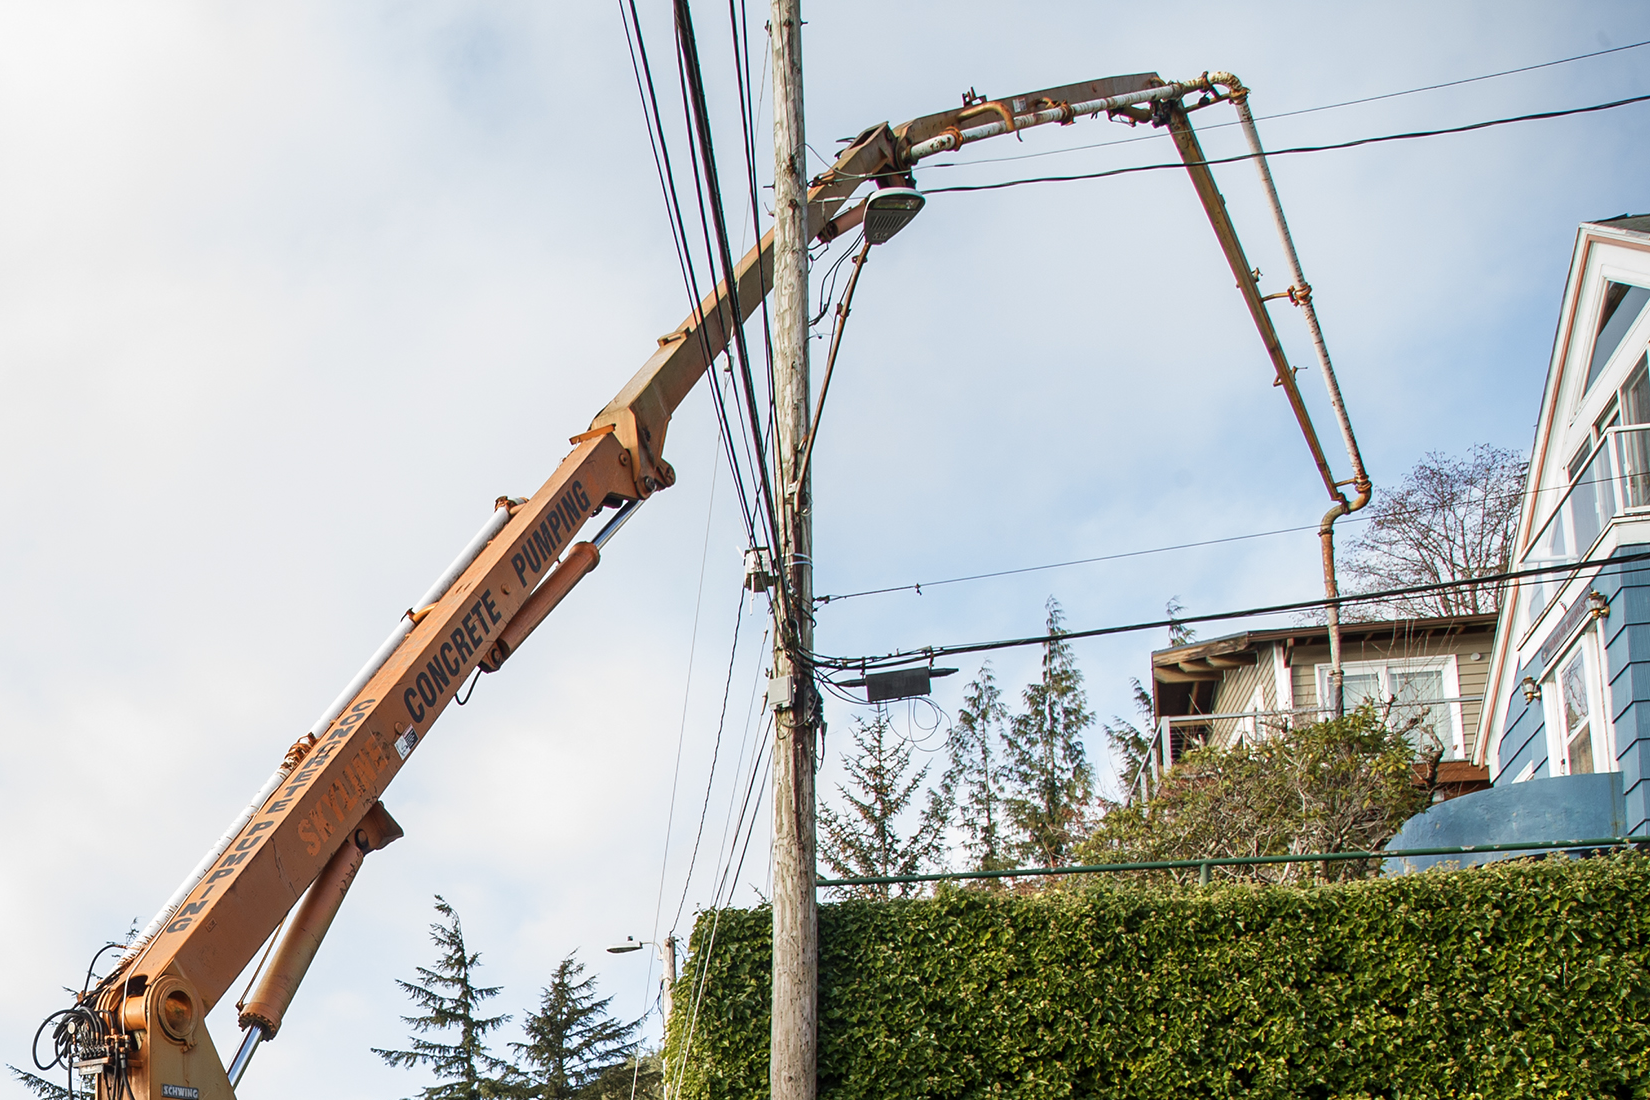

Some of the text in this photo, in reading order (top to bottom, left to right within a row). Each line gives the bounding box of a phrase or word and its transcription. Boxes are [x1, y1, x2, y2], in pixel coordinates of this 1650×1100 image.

[403, 480, 591, 724] CONCRETE PUMPING
[166, 699, 376, 934] CONCRETE PUMPING
[163, 1085, 198, 1099] SCHWING
